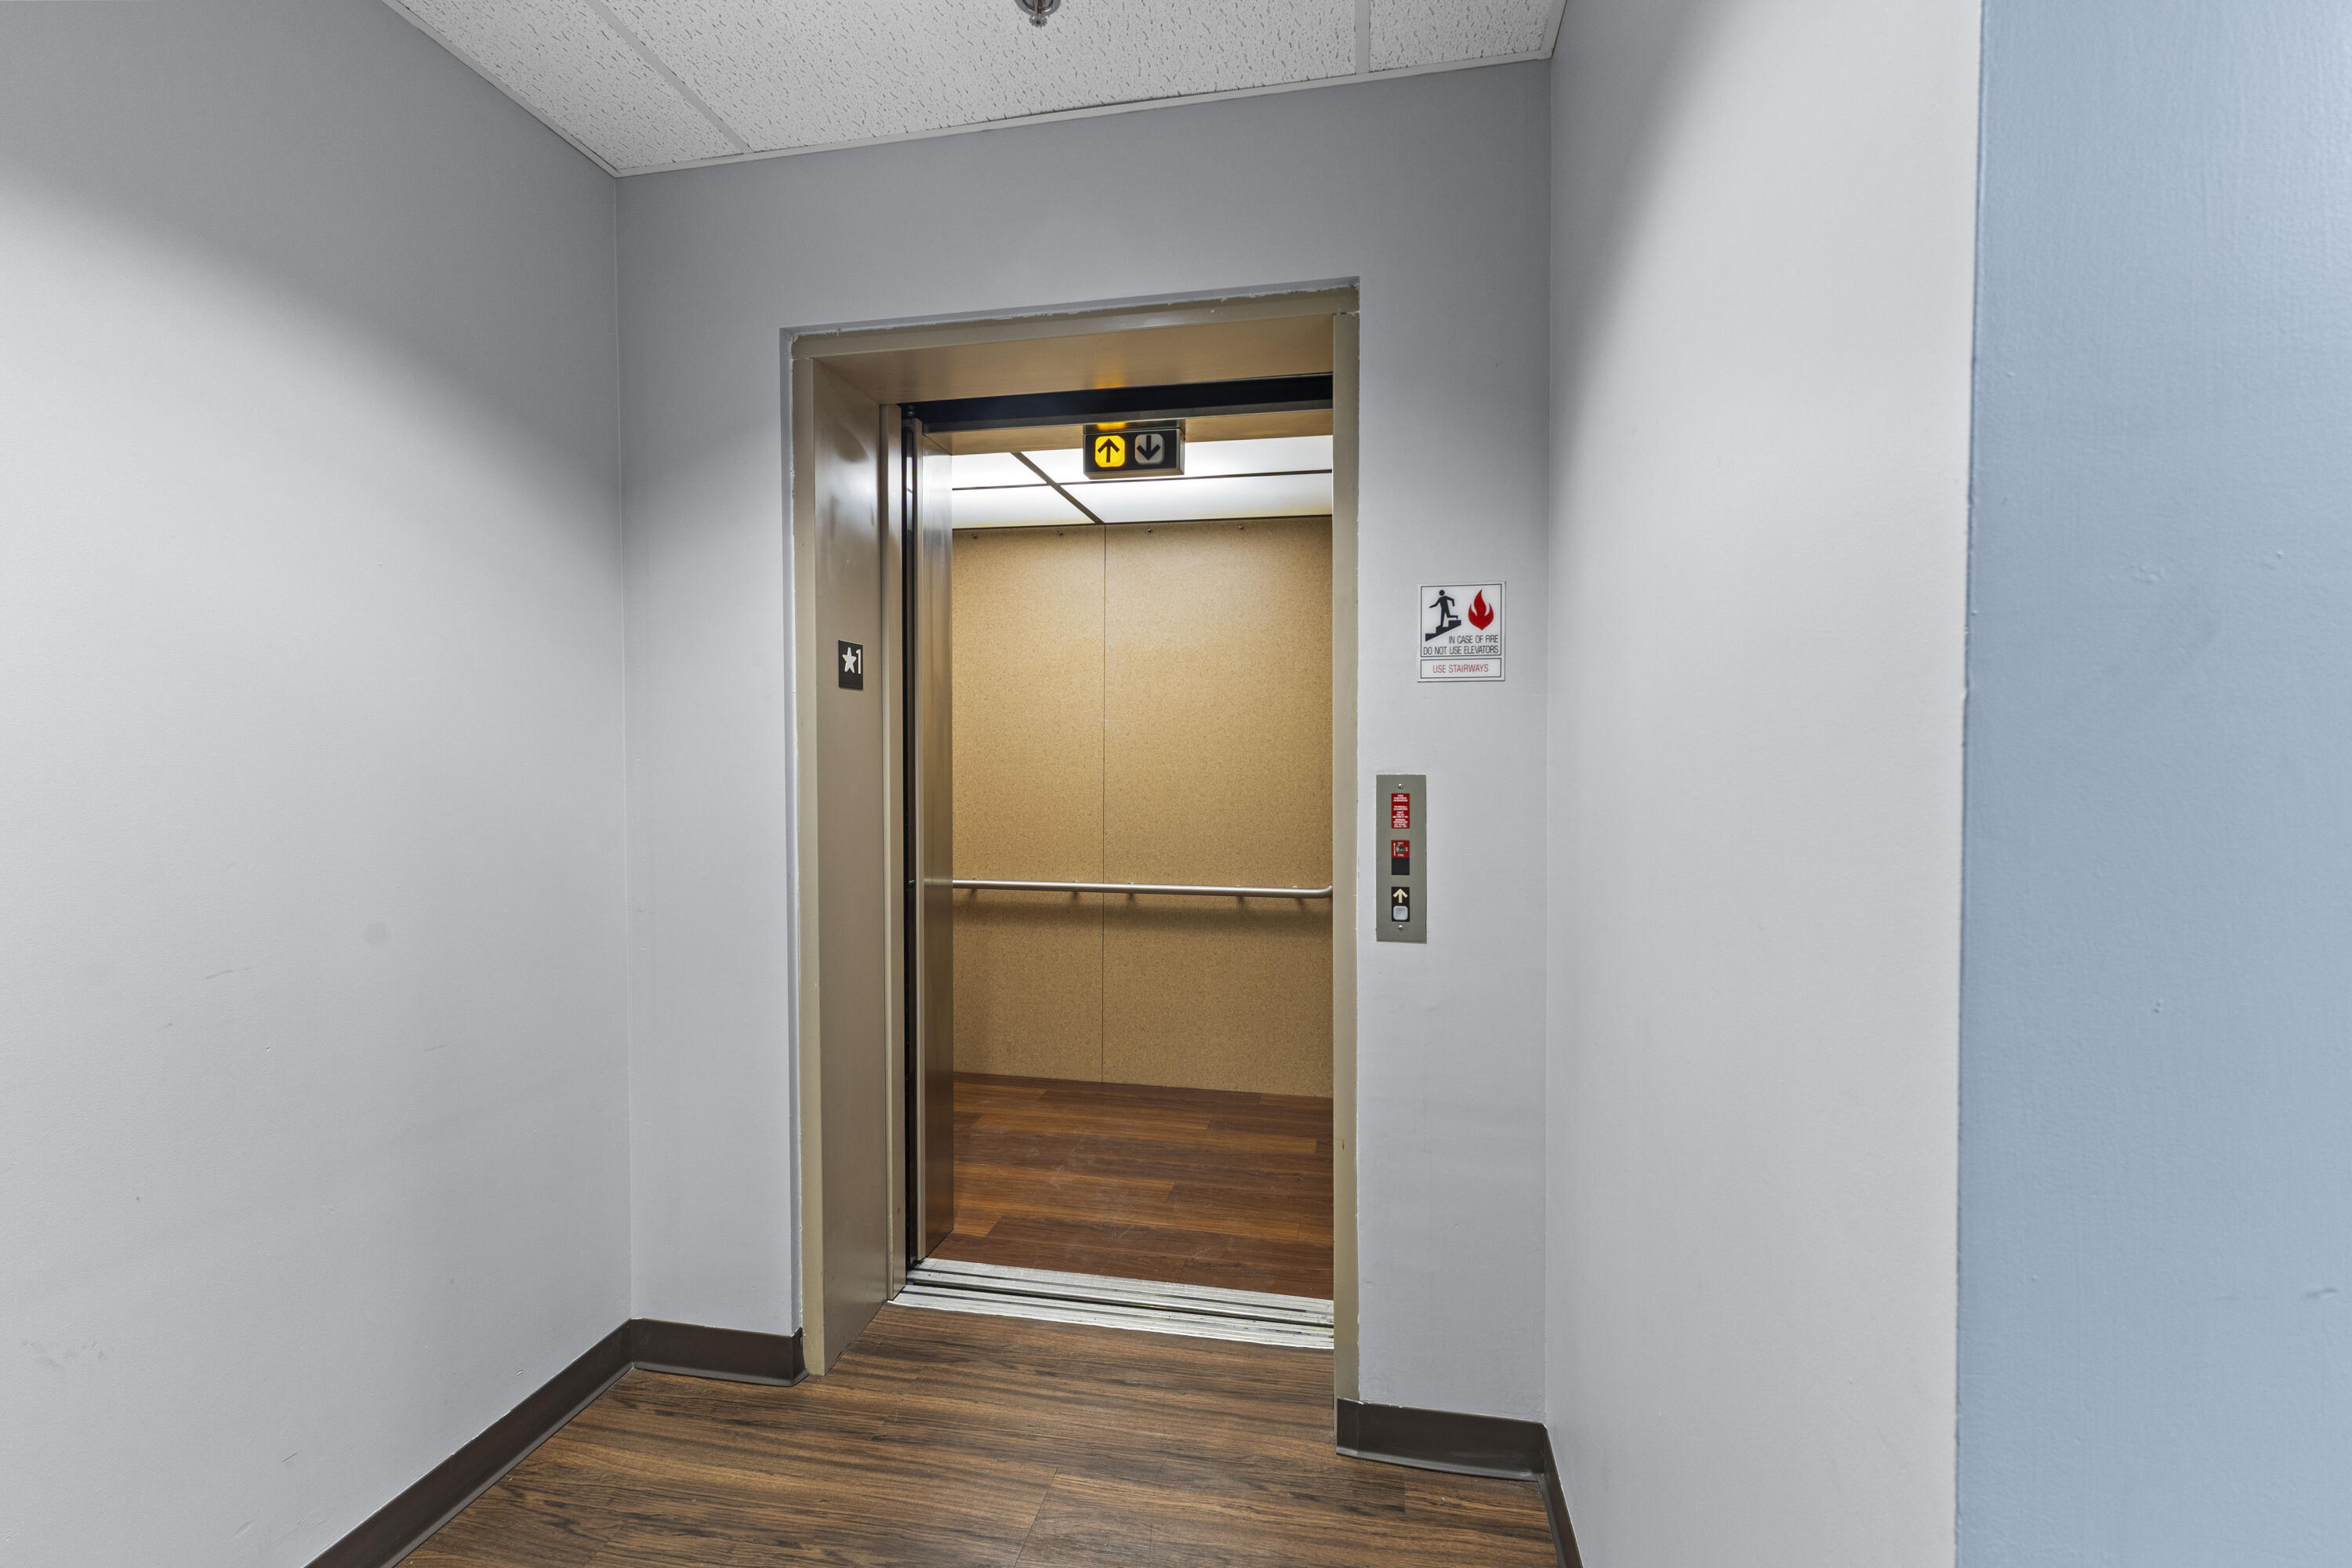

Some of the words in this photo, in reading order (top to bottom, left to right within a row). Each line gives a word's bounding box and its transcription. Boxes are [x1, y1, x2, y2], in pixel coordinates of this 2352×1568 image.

[1464, 645, 1498, 654] ELEVATORS
[856, 649, 861, 674] 1
[1449, 664, 1489, 673] STAIRWAYS
